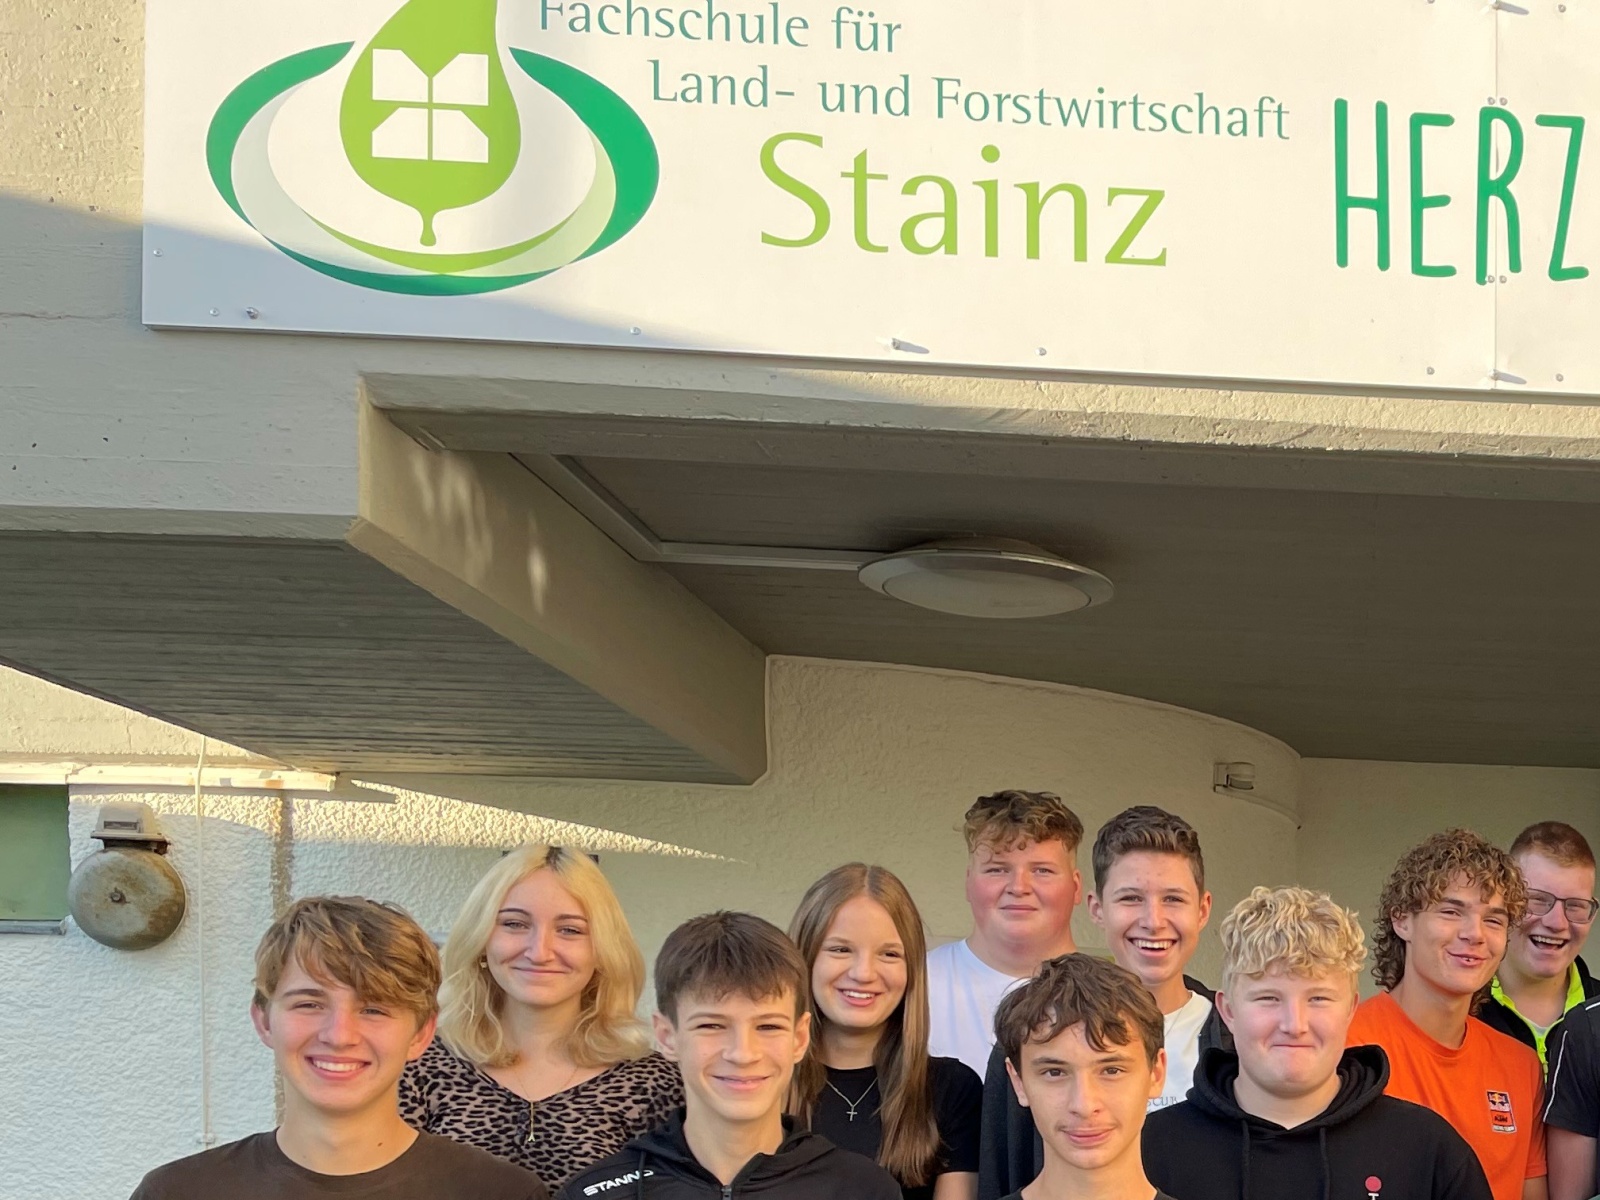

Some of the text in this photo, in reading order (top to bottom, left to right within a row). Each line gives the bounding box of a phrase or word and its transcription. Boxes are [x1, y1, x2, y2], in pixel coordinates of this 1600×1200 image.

[539, 0, 902, 52] Fachschule für
[647, 59, 1290, 139] Land- und Forstwirtschaft
[759, 132, 1168, 266] Stainz
